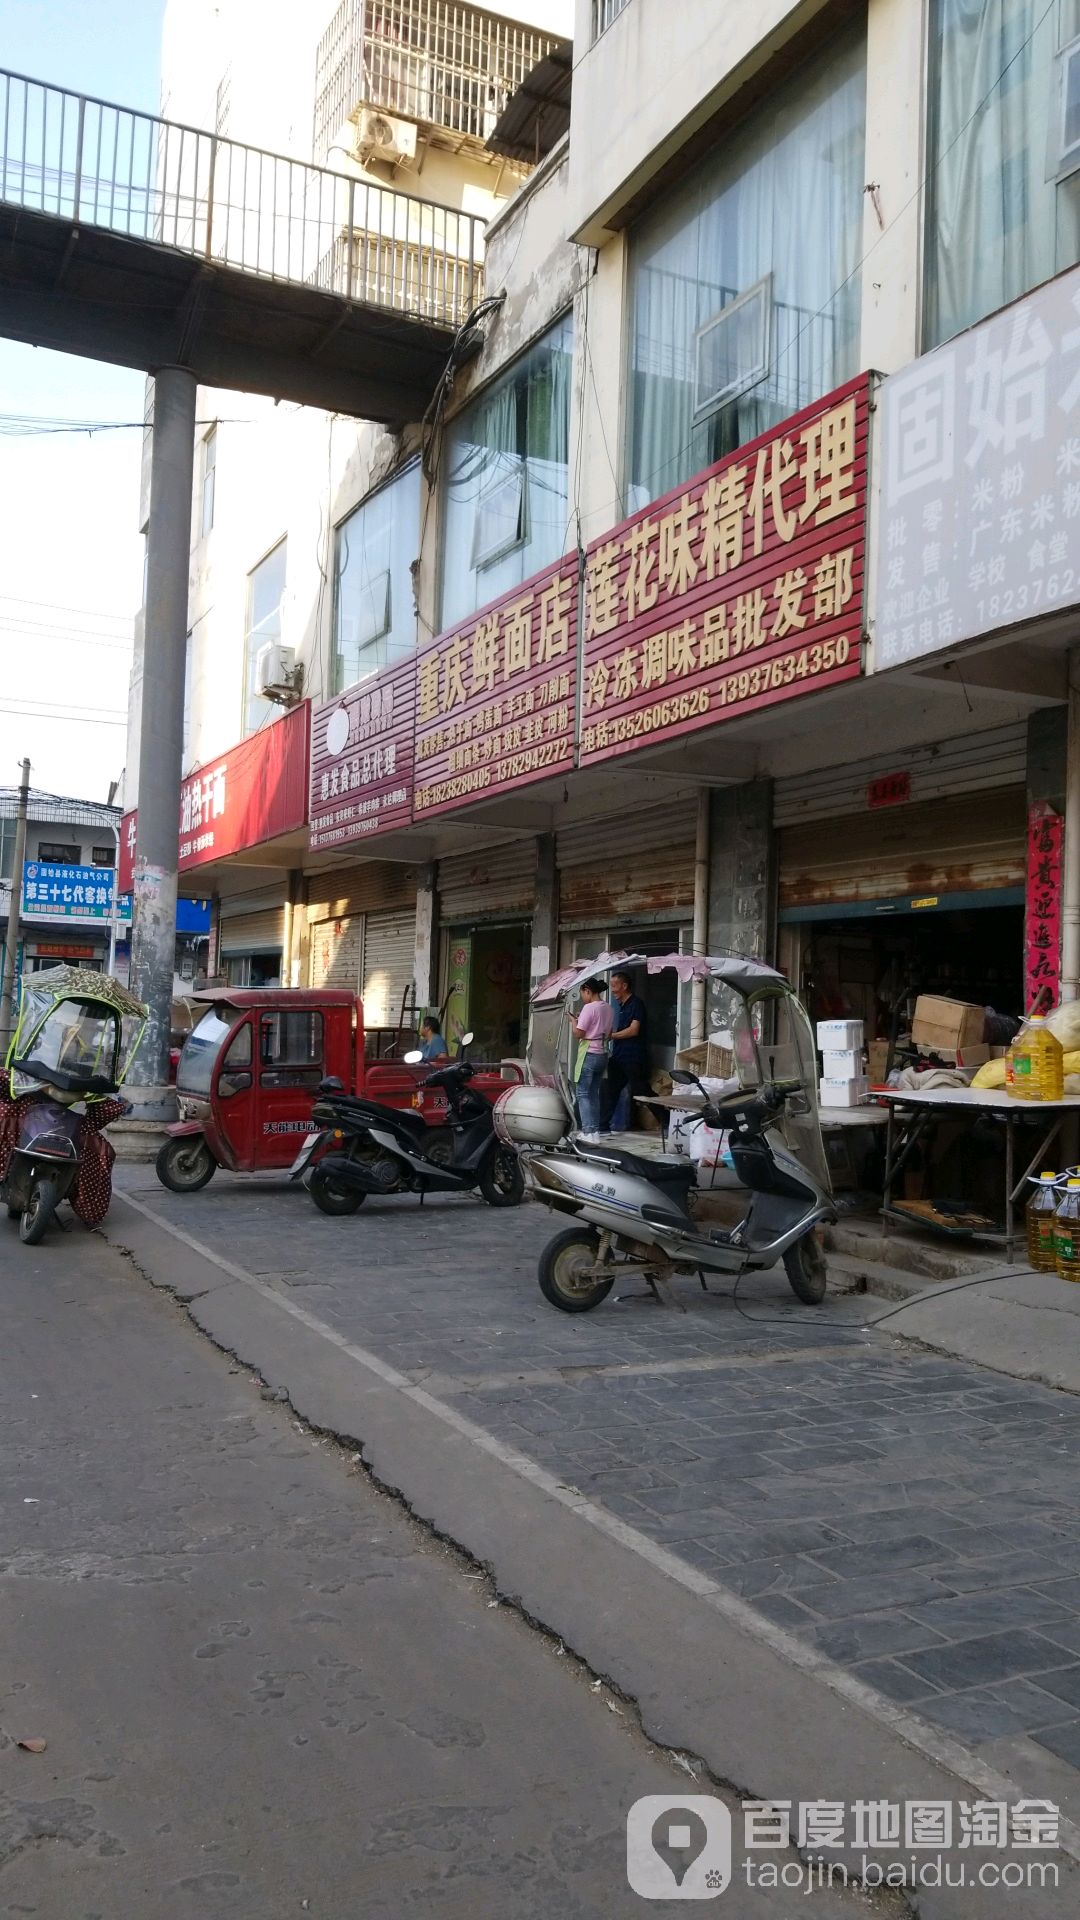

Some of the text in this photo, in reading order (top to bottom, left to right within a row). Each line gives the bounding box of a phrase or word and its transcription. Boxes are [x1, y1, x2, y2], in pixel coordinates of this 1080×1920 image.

[887, 287, 1080, 509] 固始
[585, 399, 858, 640] 莲花味精代理
[976, 567, 1080, 622] 1823762
[416, 575, 574, 726] 重庆鲜面店
[586, 547, 854, 709] 冷冻调味品批发部
[719, 635, 850, 707] 13937634350
[320, 743, 397, 802] 惠发食品总代理
